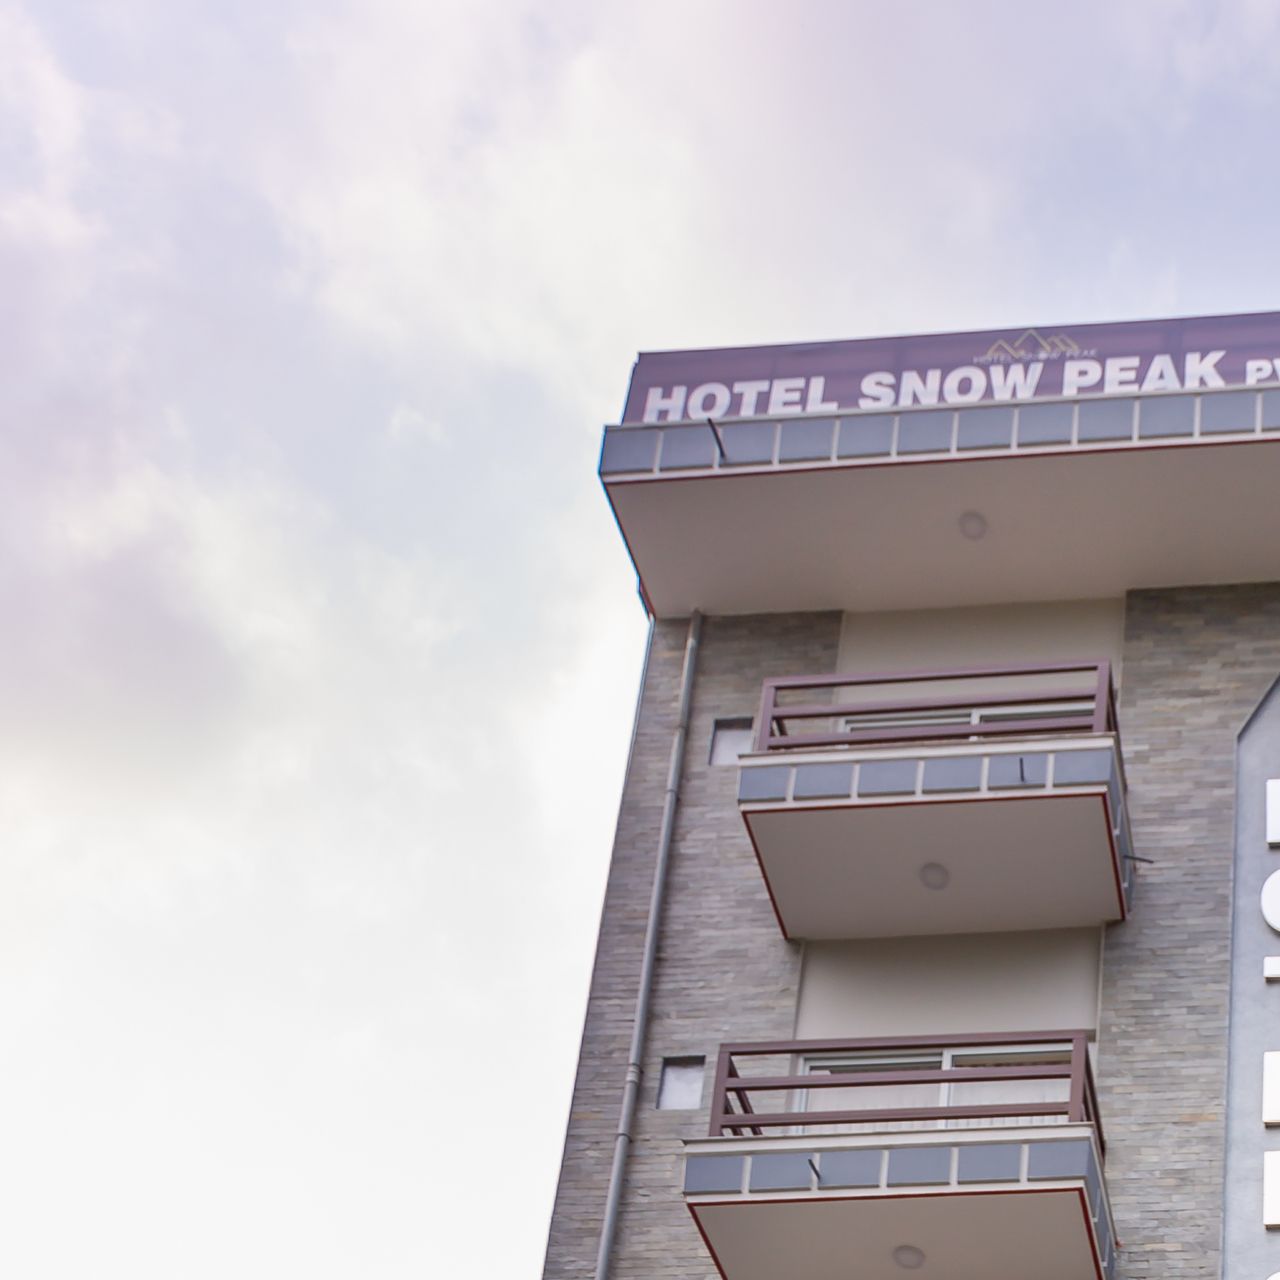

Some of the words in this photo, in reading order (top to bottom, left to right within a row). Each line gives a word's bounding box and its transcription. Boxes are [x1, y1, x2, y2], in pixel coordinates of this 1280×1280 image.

[643, 376, 838, 423] HOTEL
[858, 361, 1044, 410] SNOW
[1062, 350, 1226, 396] PEAK
